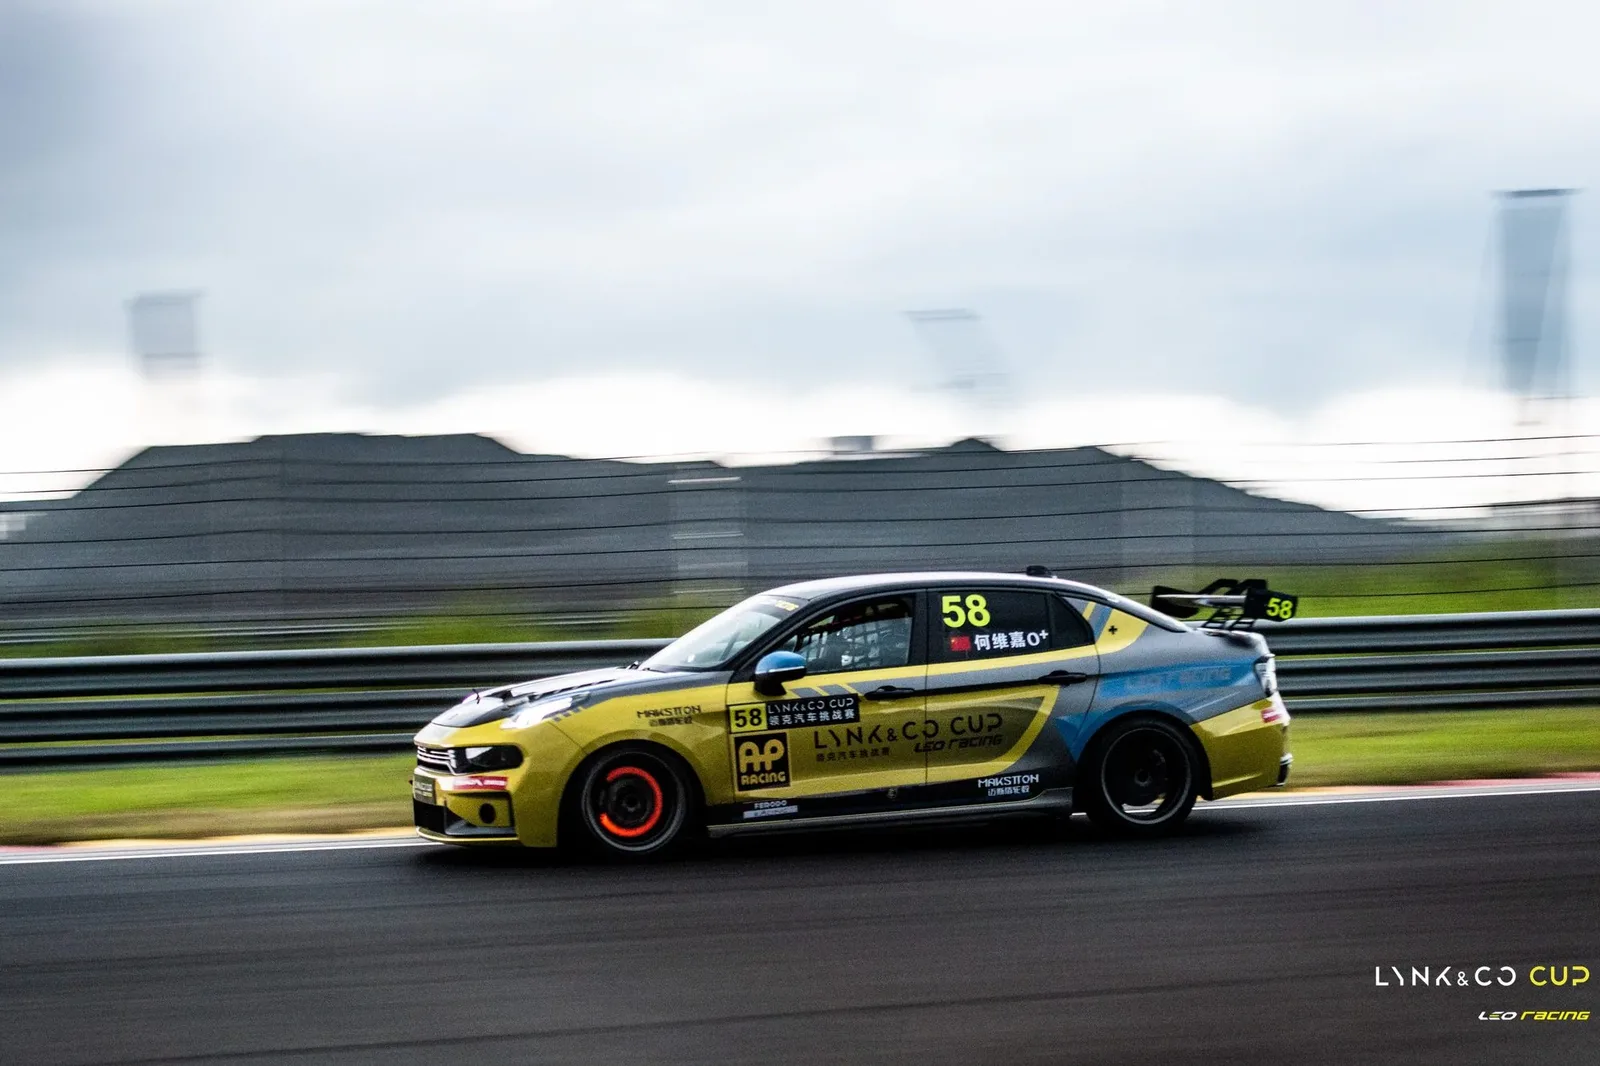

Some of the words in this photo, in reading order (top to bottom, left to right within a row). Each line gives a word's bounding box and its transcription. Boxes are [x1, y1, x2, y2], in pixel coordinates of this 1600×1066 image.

[942, 594, 991, 628] 58
[1266, 597, 1293, 619] 58
[829, 697, 854, 708] CUP
[734, 708, 762, 728] 58
[769, 708, 855, 726] 领克汽车挑战赛
[951, 713, 1003, 736] CUP
[738, 739, 785, 773] AP
